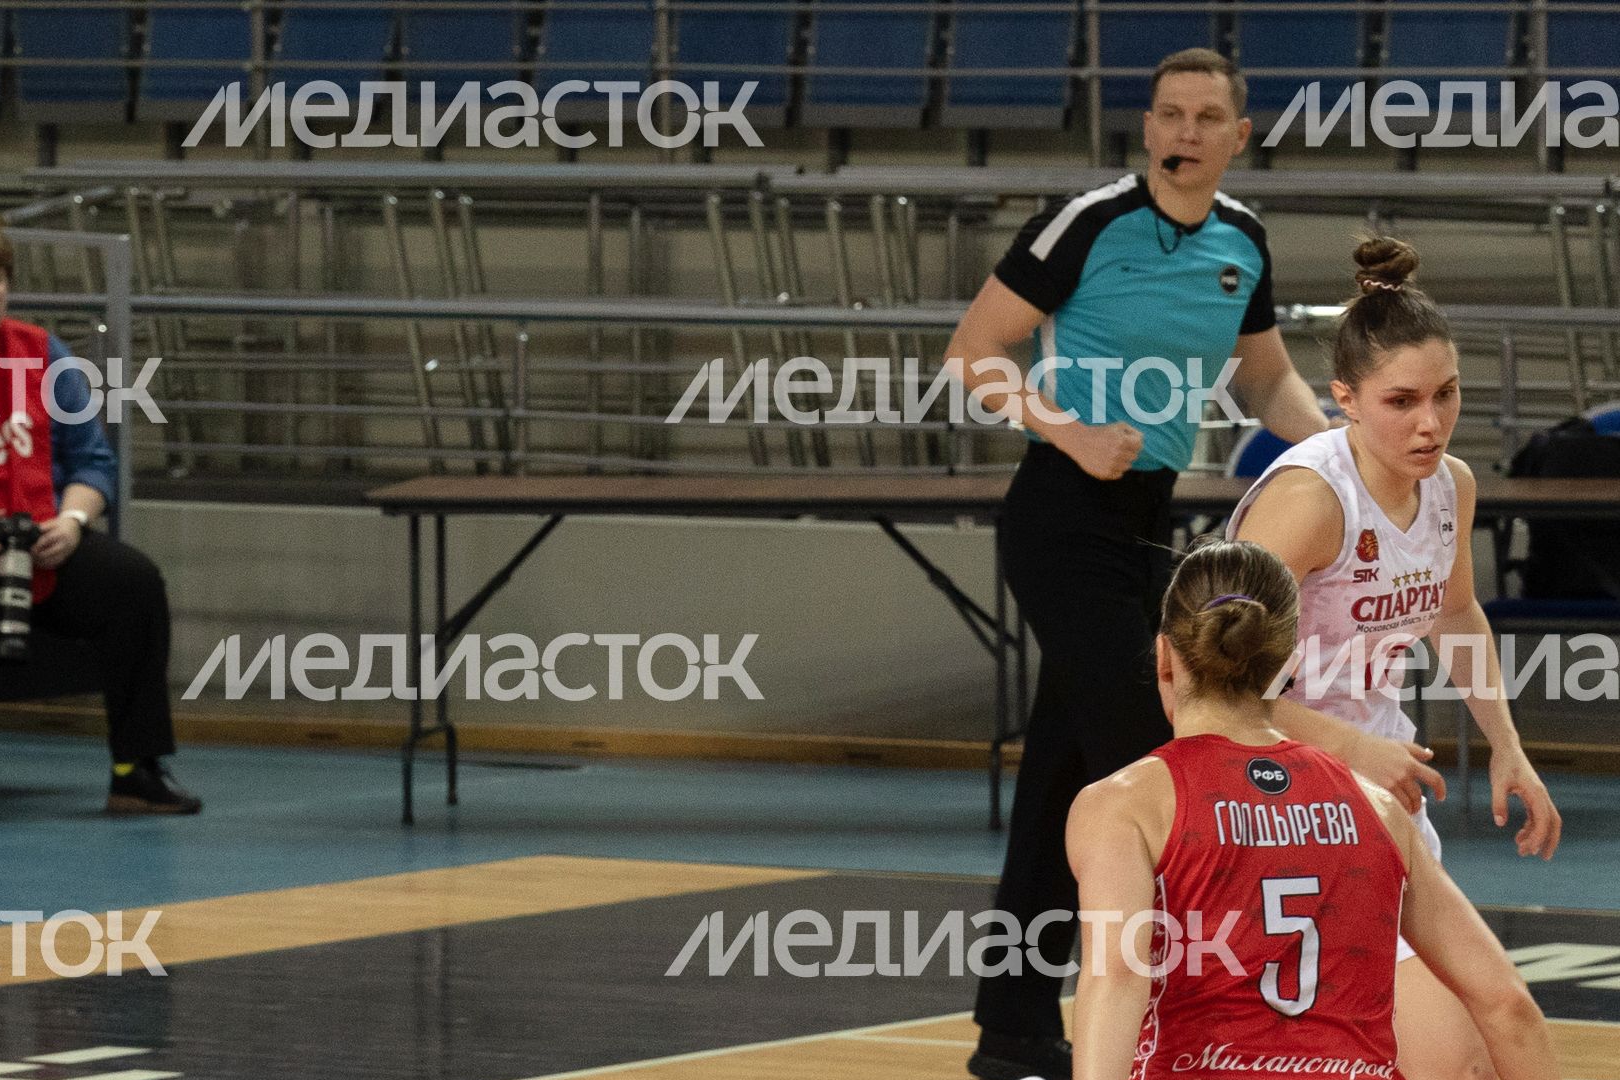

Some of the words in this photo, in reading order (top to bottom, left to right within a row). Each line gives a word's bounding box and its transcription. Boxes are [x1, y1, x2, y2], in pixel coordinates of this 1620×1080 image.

[1252, 769, 1285, 781] РФБ
[1214, 800, 1359, 847] ГОЛДЫРЕВА
[1259, 876, 1321, 1017] 5
